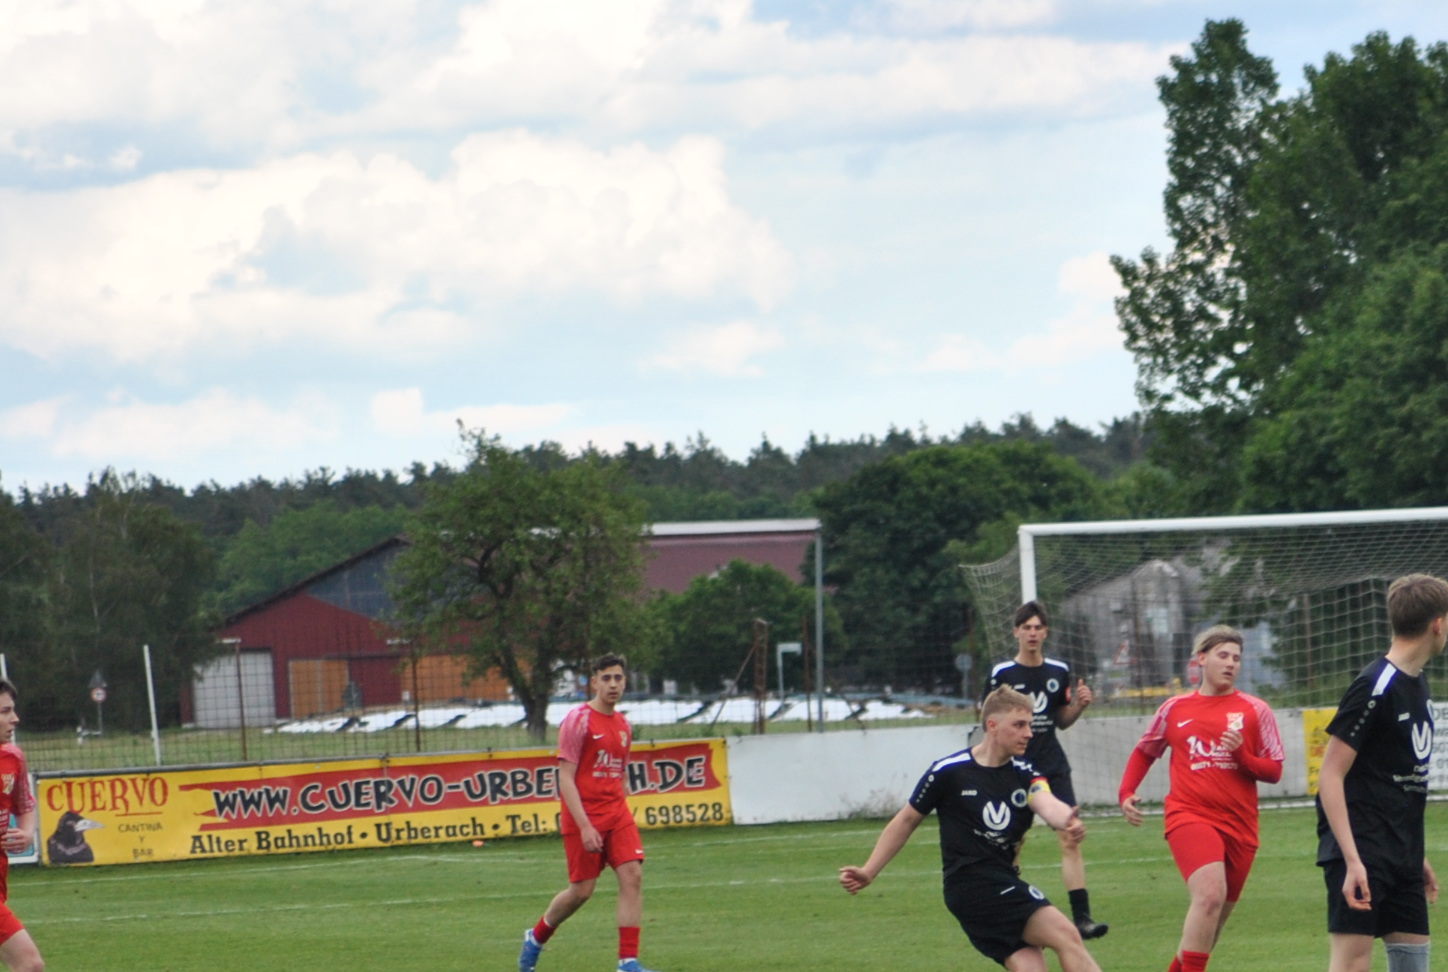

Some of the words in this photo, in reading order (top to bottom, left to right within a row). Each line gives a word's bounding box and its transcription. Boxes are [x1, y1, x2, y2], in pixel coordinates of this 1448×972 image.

[46, 776, 169, 815] CUERVO
[212, 755, 706, 821] WWW.CUERVO-URBEH.DE
[117, 821, 164, 834] CANTINA
[189, 834, 248, 855] Alter
[255, 825, 354, 853] Bahnhof
[374, 816, 486, 844] Urberach
[506, 813, 548, 834] Tel:
[645, 802, 724, 826] 698528
